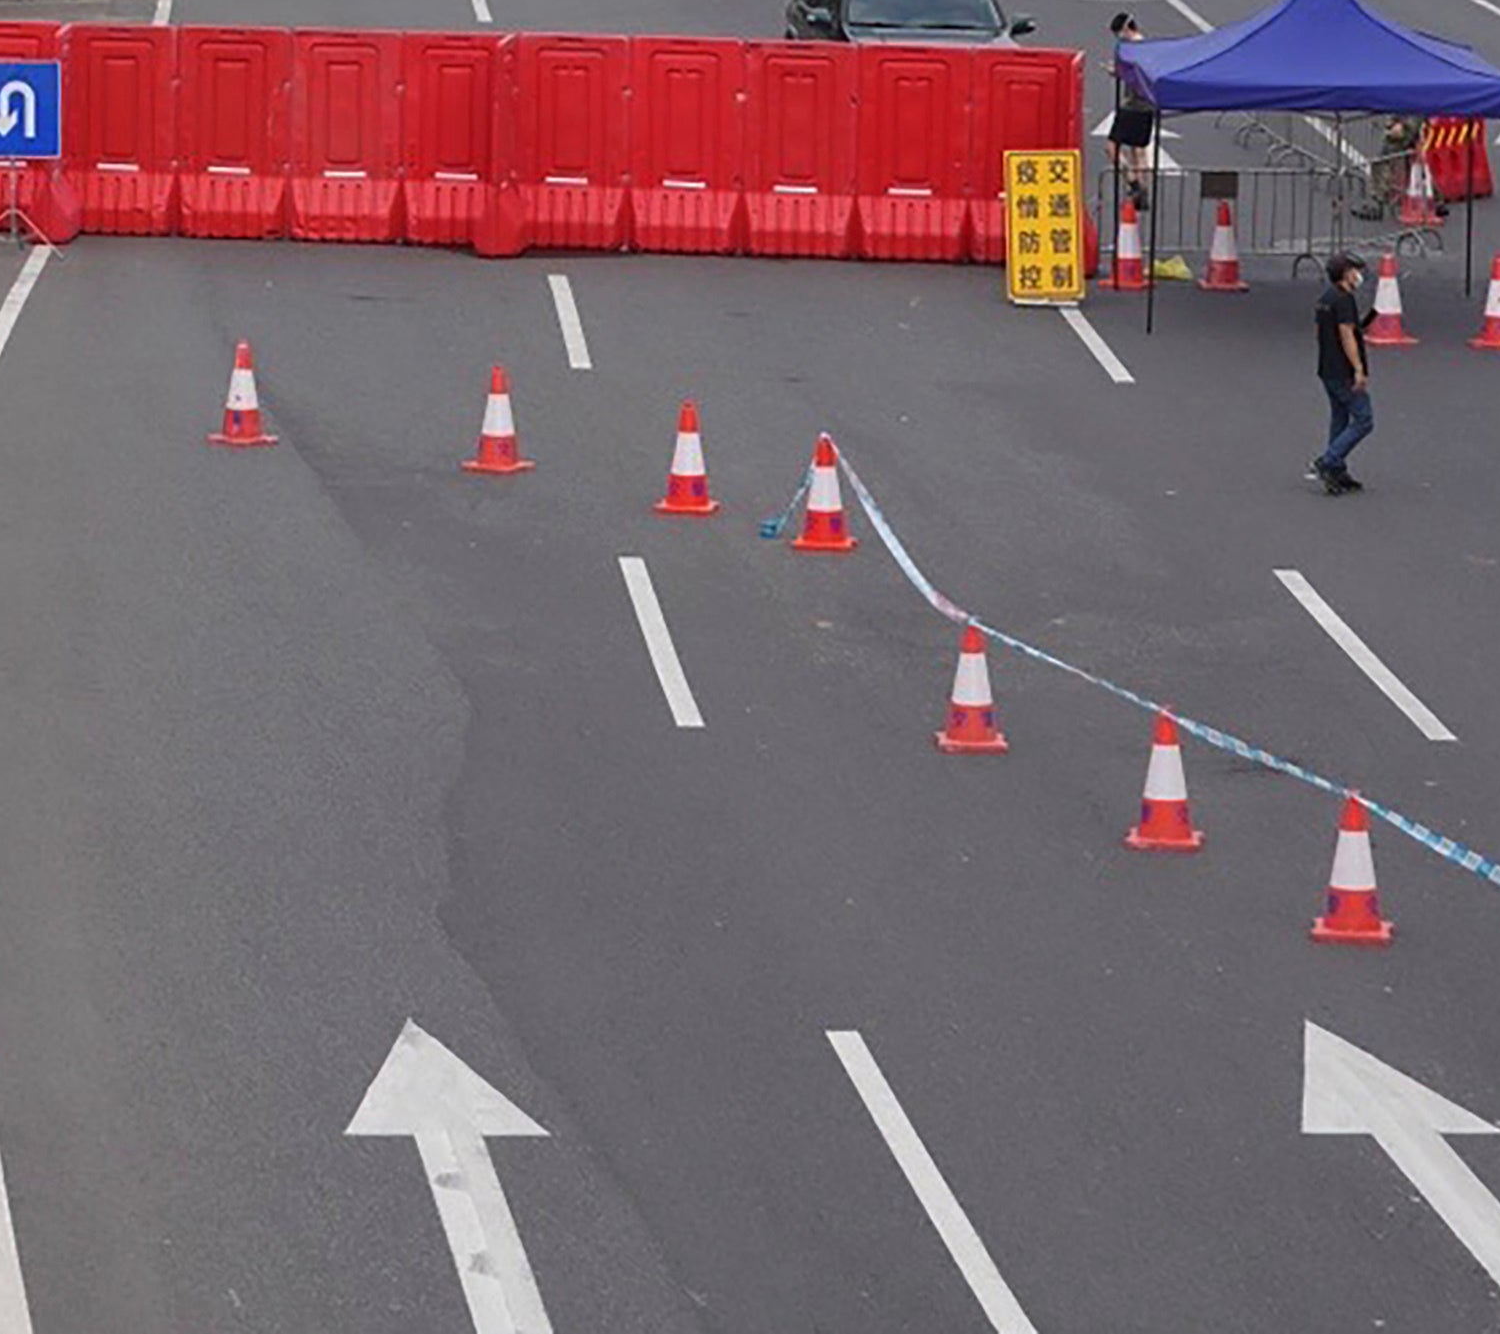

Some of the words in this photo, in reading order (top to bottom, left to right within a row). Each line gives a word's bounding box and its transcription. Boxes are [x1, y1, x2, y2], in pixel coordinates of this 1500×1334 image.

[1016, 158, 1043, 290] 疫情防控
[1048, 158, 1074, 289] 交通管制
